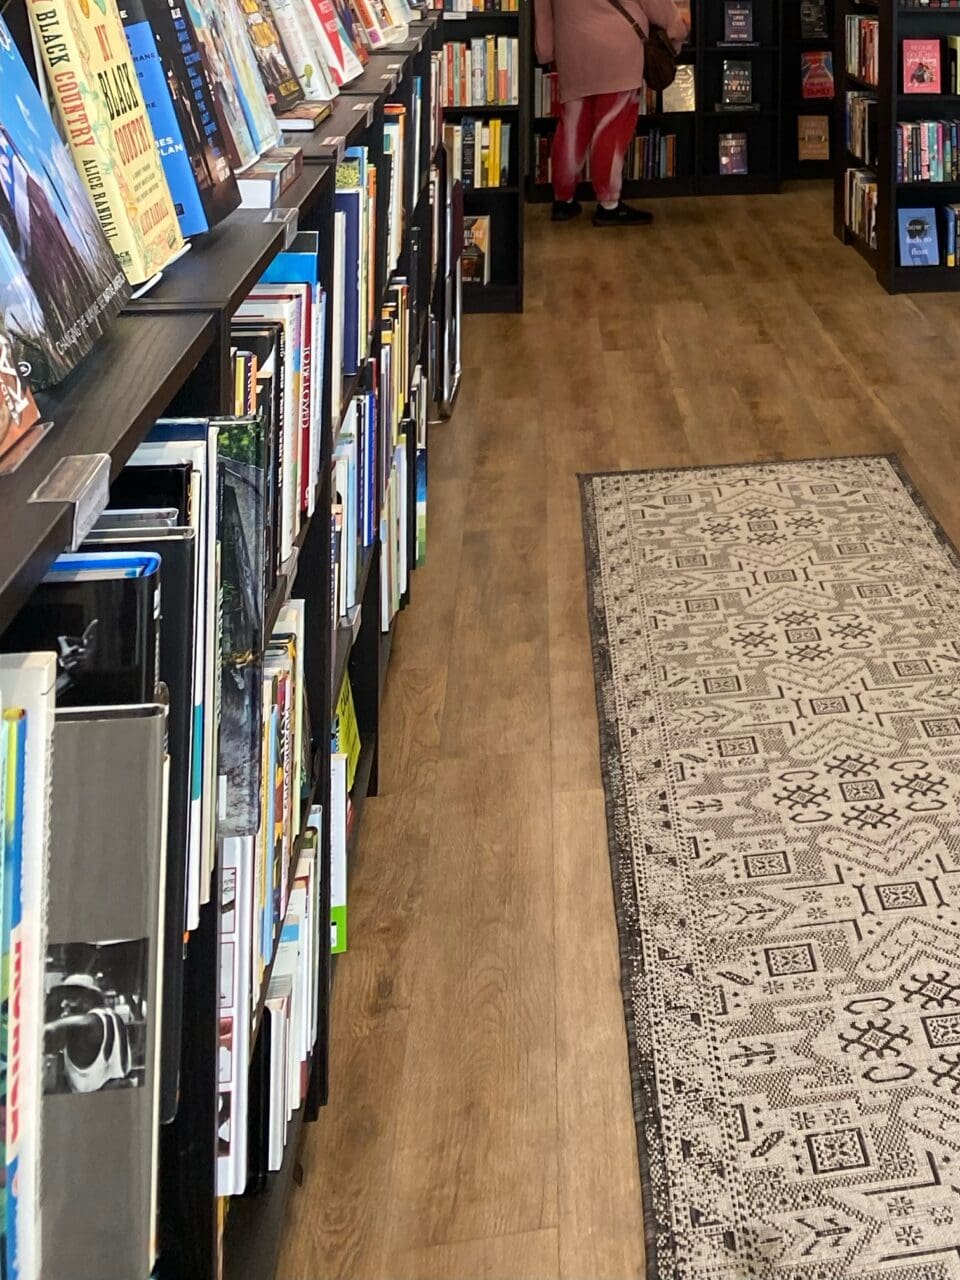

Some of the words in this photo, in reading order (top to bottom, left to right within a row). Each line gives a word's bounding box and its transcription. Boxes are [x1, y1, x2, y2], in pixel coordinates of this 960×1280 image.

[35, 8, 71, 68] BLACK
[54, 70, 95, 148] COUNTRY
[82, 158, 97, 191] ALICE
[92, 192, 118, 241] RANDALL
[97, 62, 139, 120] BLACK
